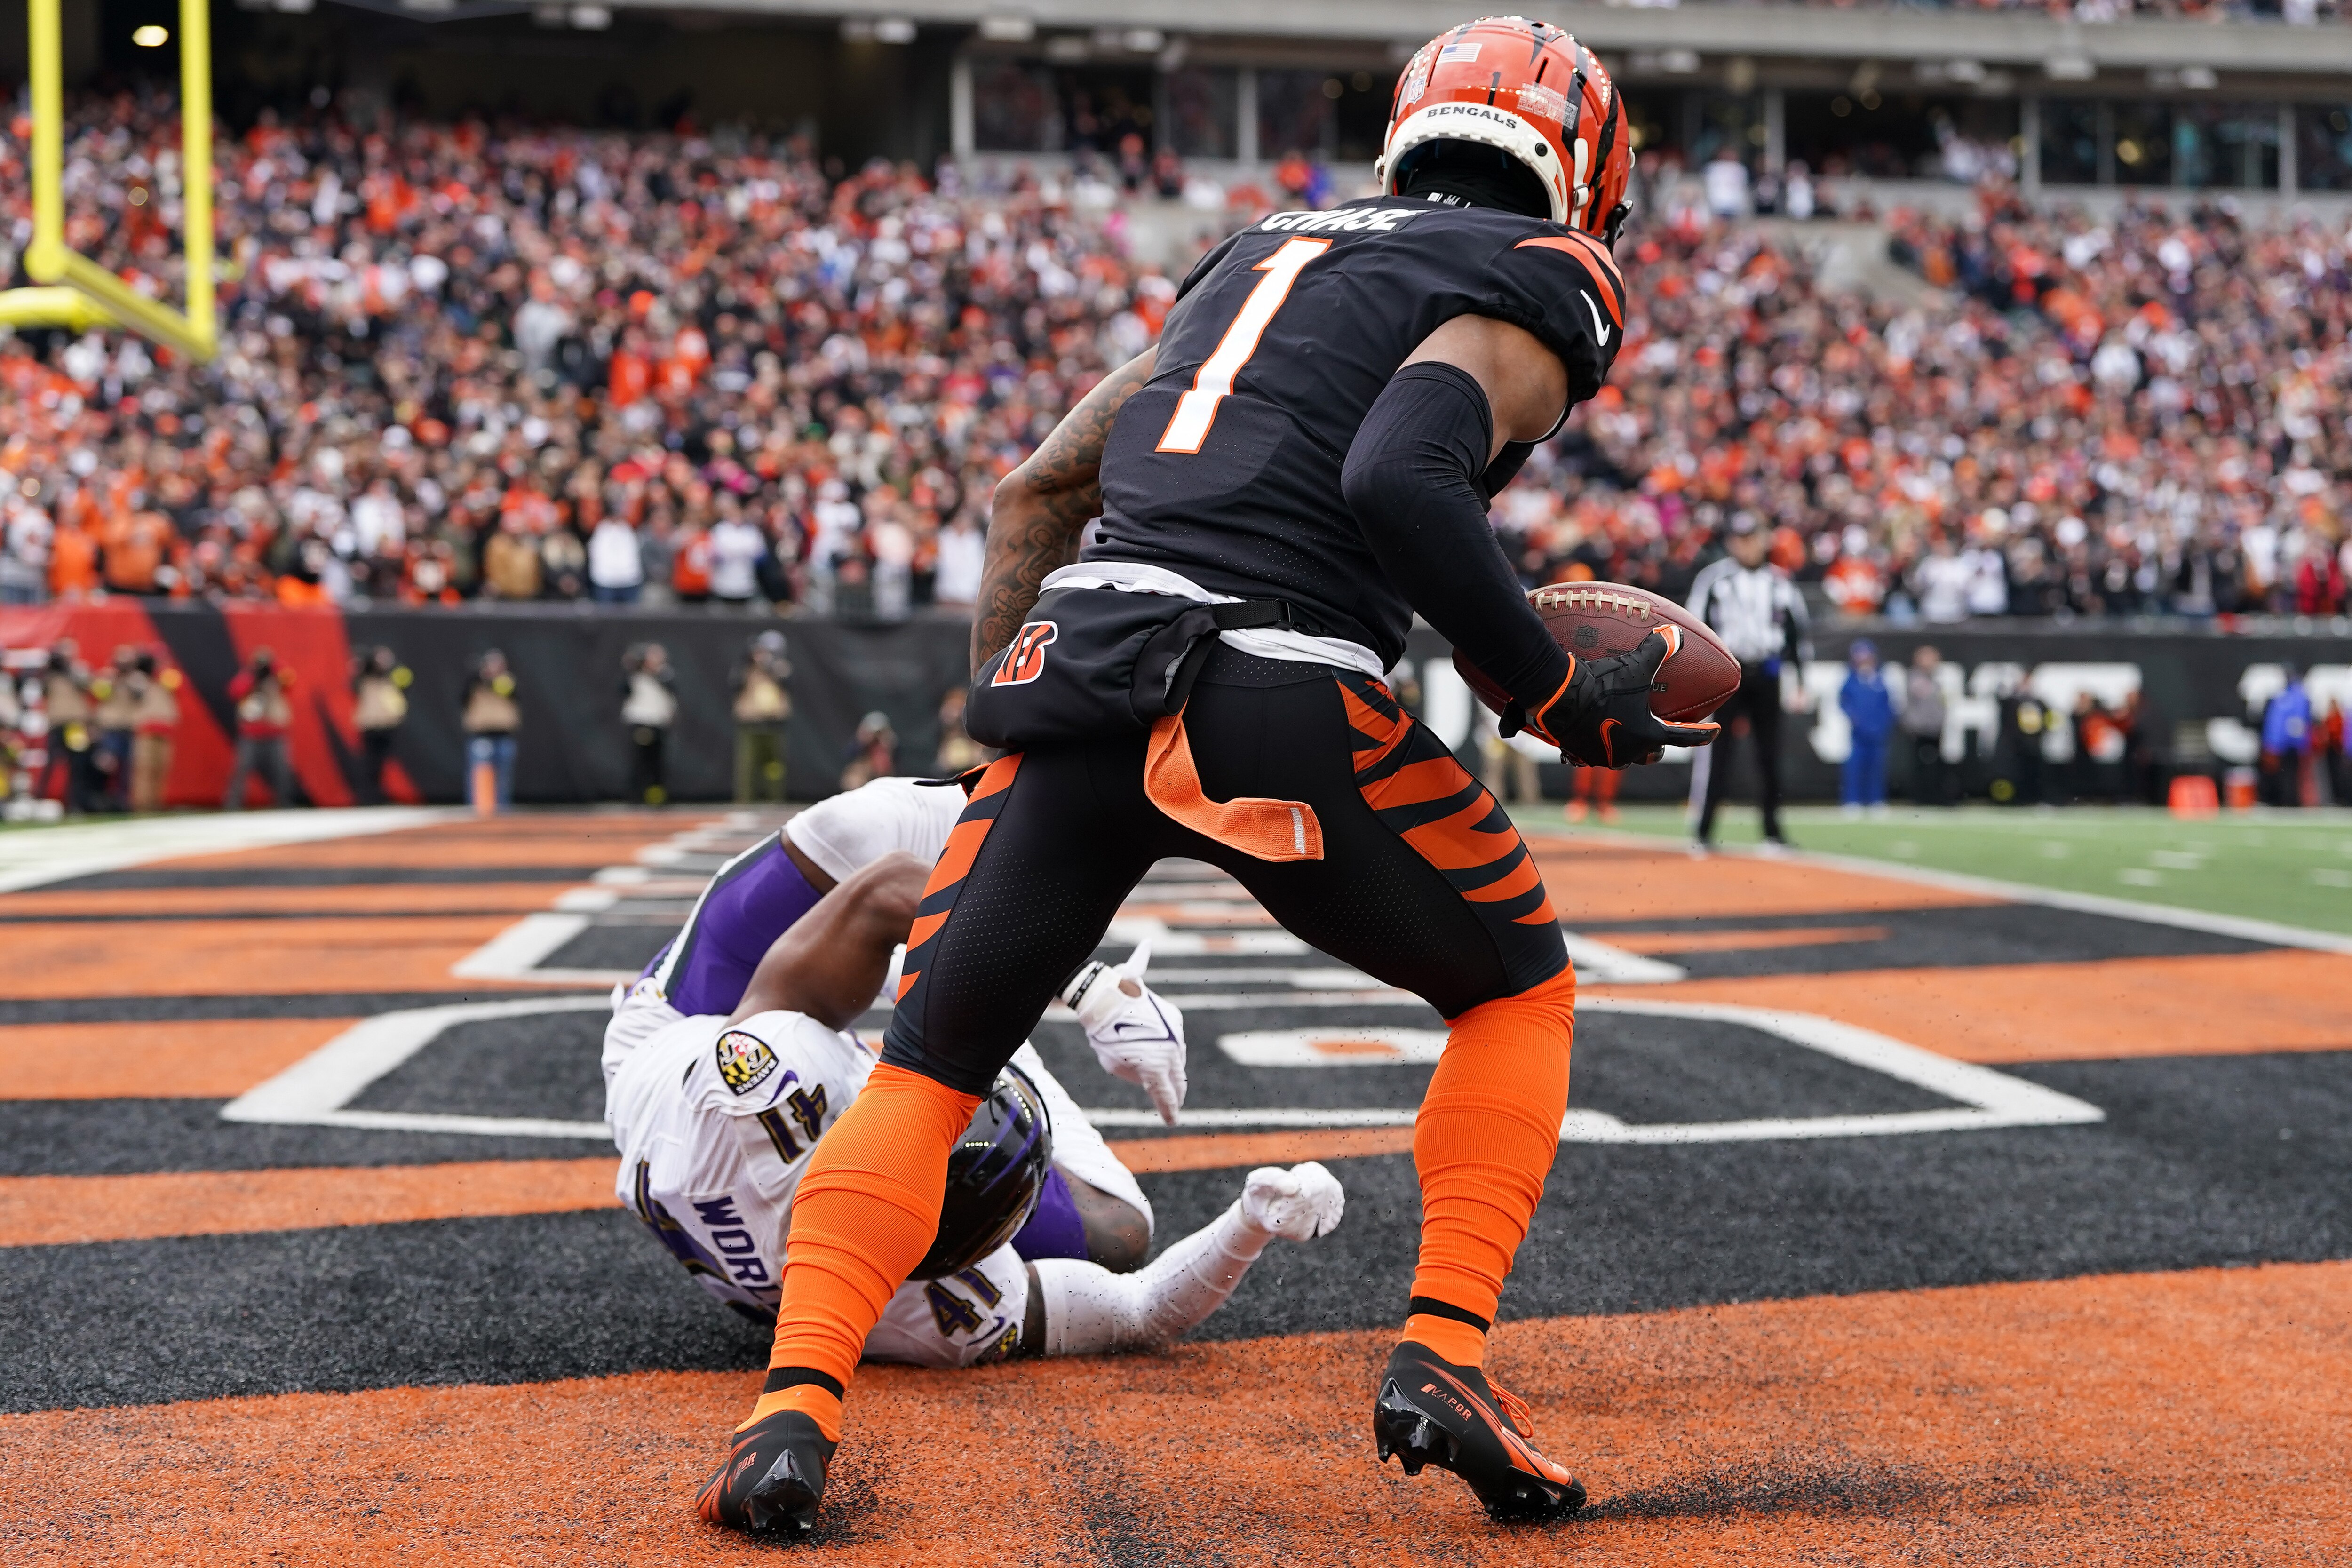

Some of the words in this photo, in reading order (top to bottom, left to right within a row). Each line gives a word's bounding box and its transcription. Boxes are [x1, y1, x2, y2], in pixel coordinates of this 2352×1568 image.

[1427, 106, 1517, 129] BENGALS
[1261, 207, 1428, 231] CHASE
[1155, 235, 1333, 454] 1
[735, 1057, 778, 1094] RAVENS
[755, 1084, 828, 1165] 41
[693, 1195, 782, 1307] WORL
[923, 1267, 1002, 1337] 41
[1425, 1383, 1472, 1421] VAPOR
